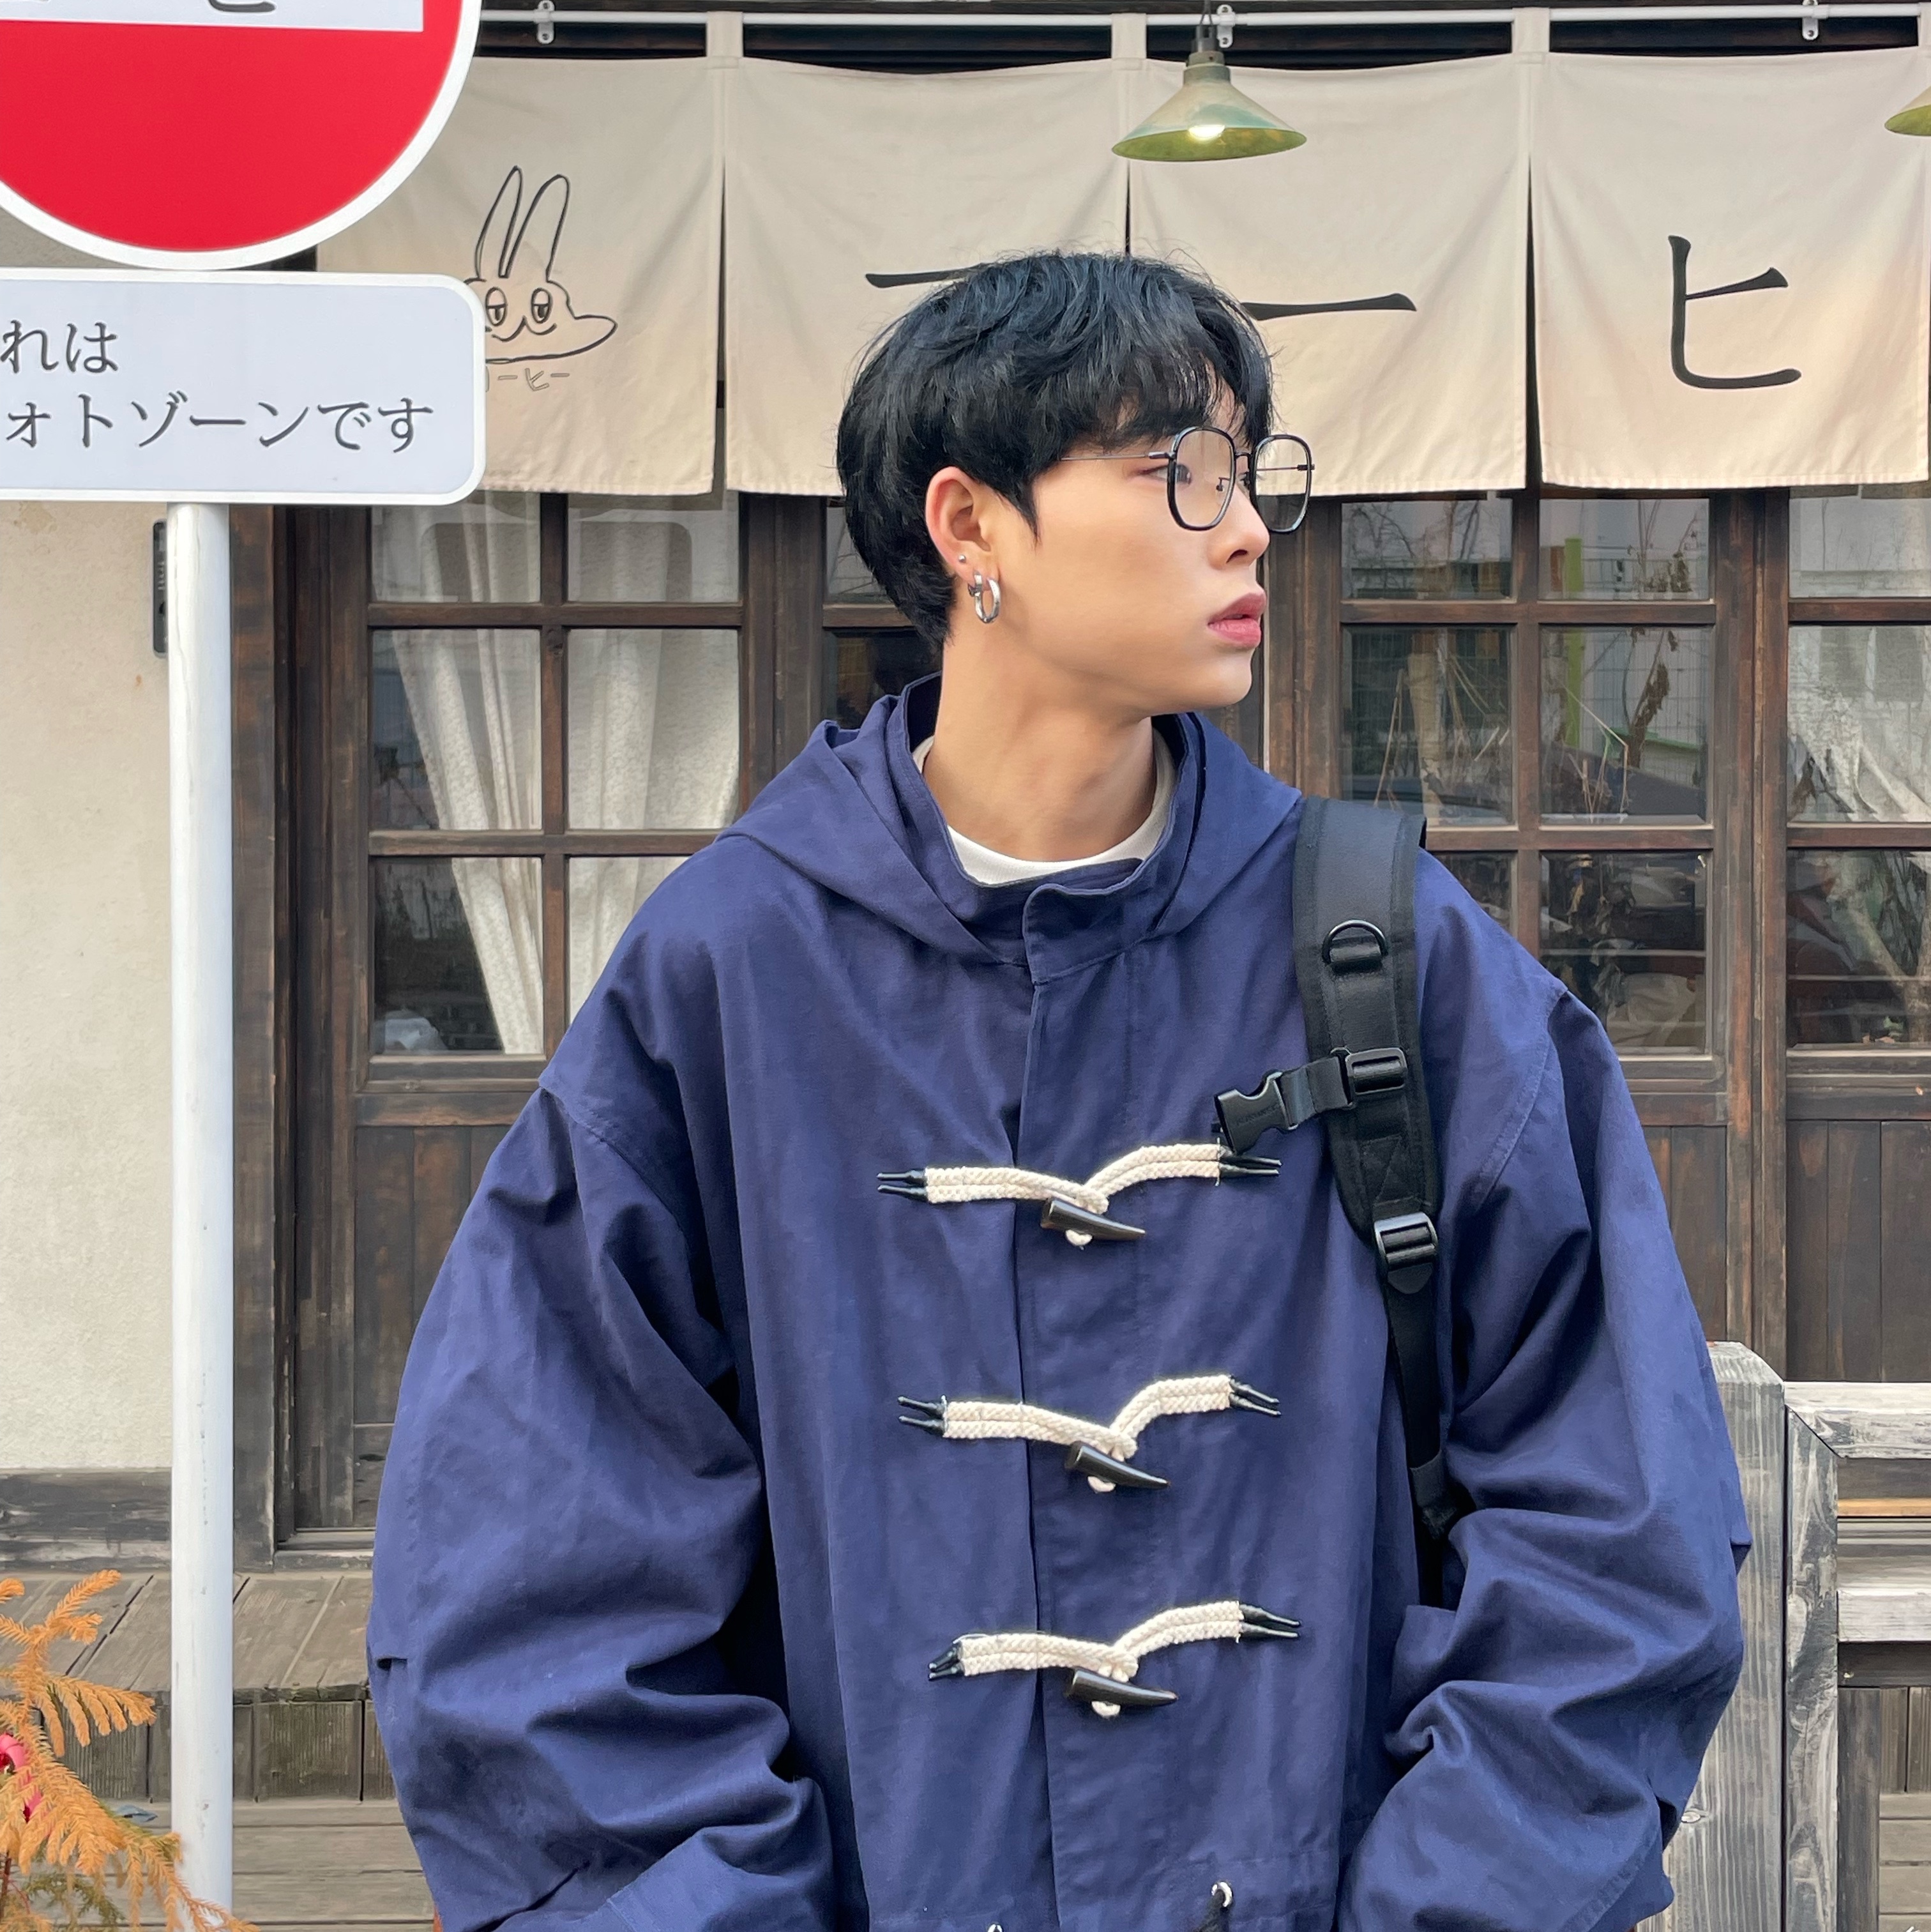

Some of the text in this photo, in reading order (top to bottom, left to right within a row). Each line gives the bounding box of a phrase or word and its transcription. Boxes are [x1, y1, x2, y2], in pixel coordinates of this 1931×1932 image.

[0, 320, 118, 374] れは
[486, 366, 570, 393] ーヒー
